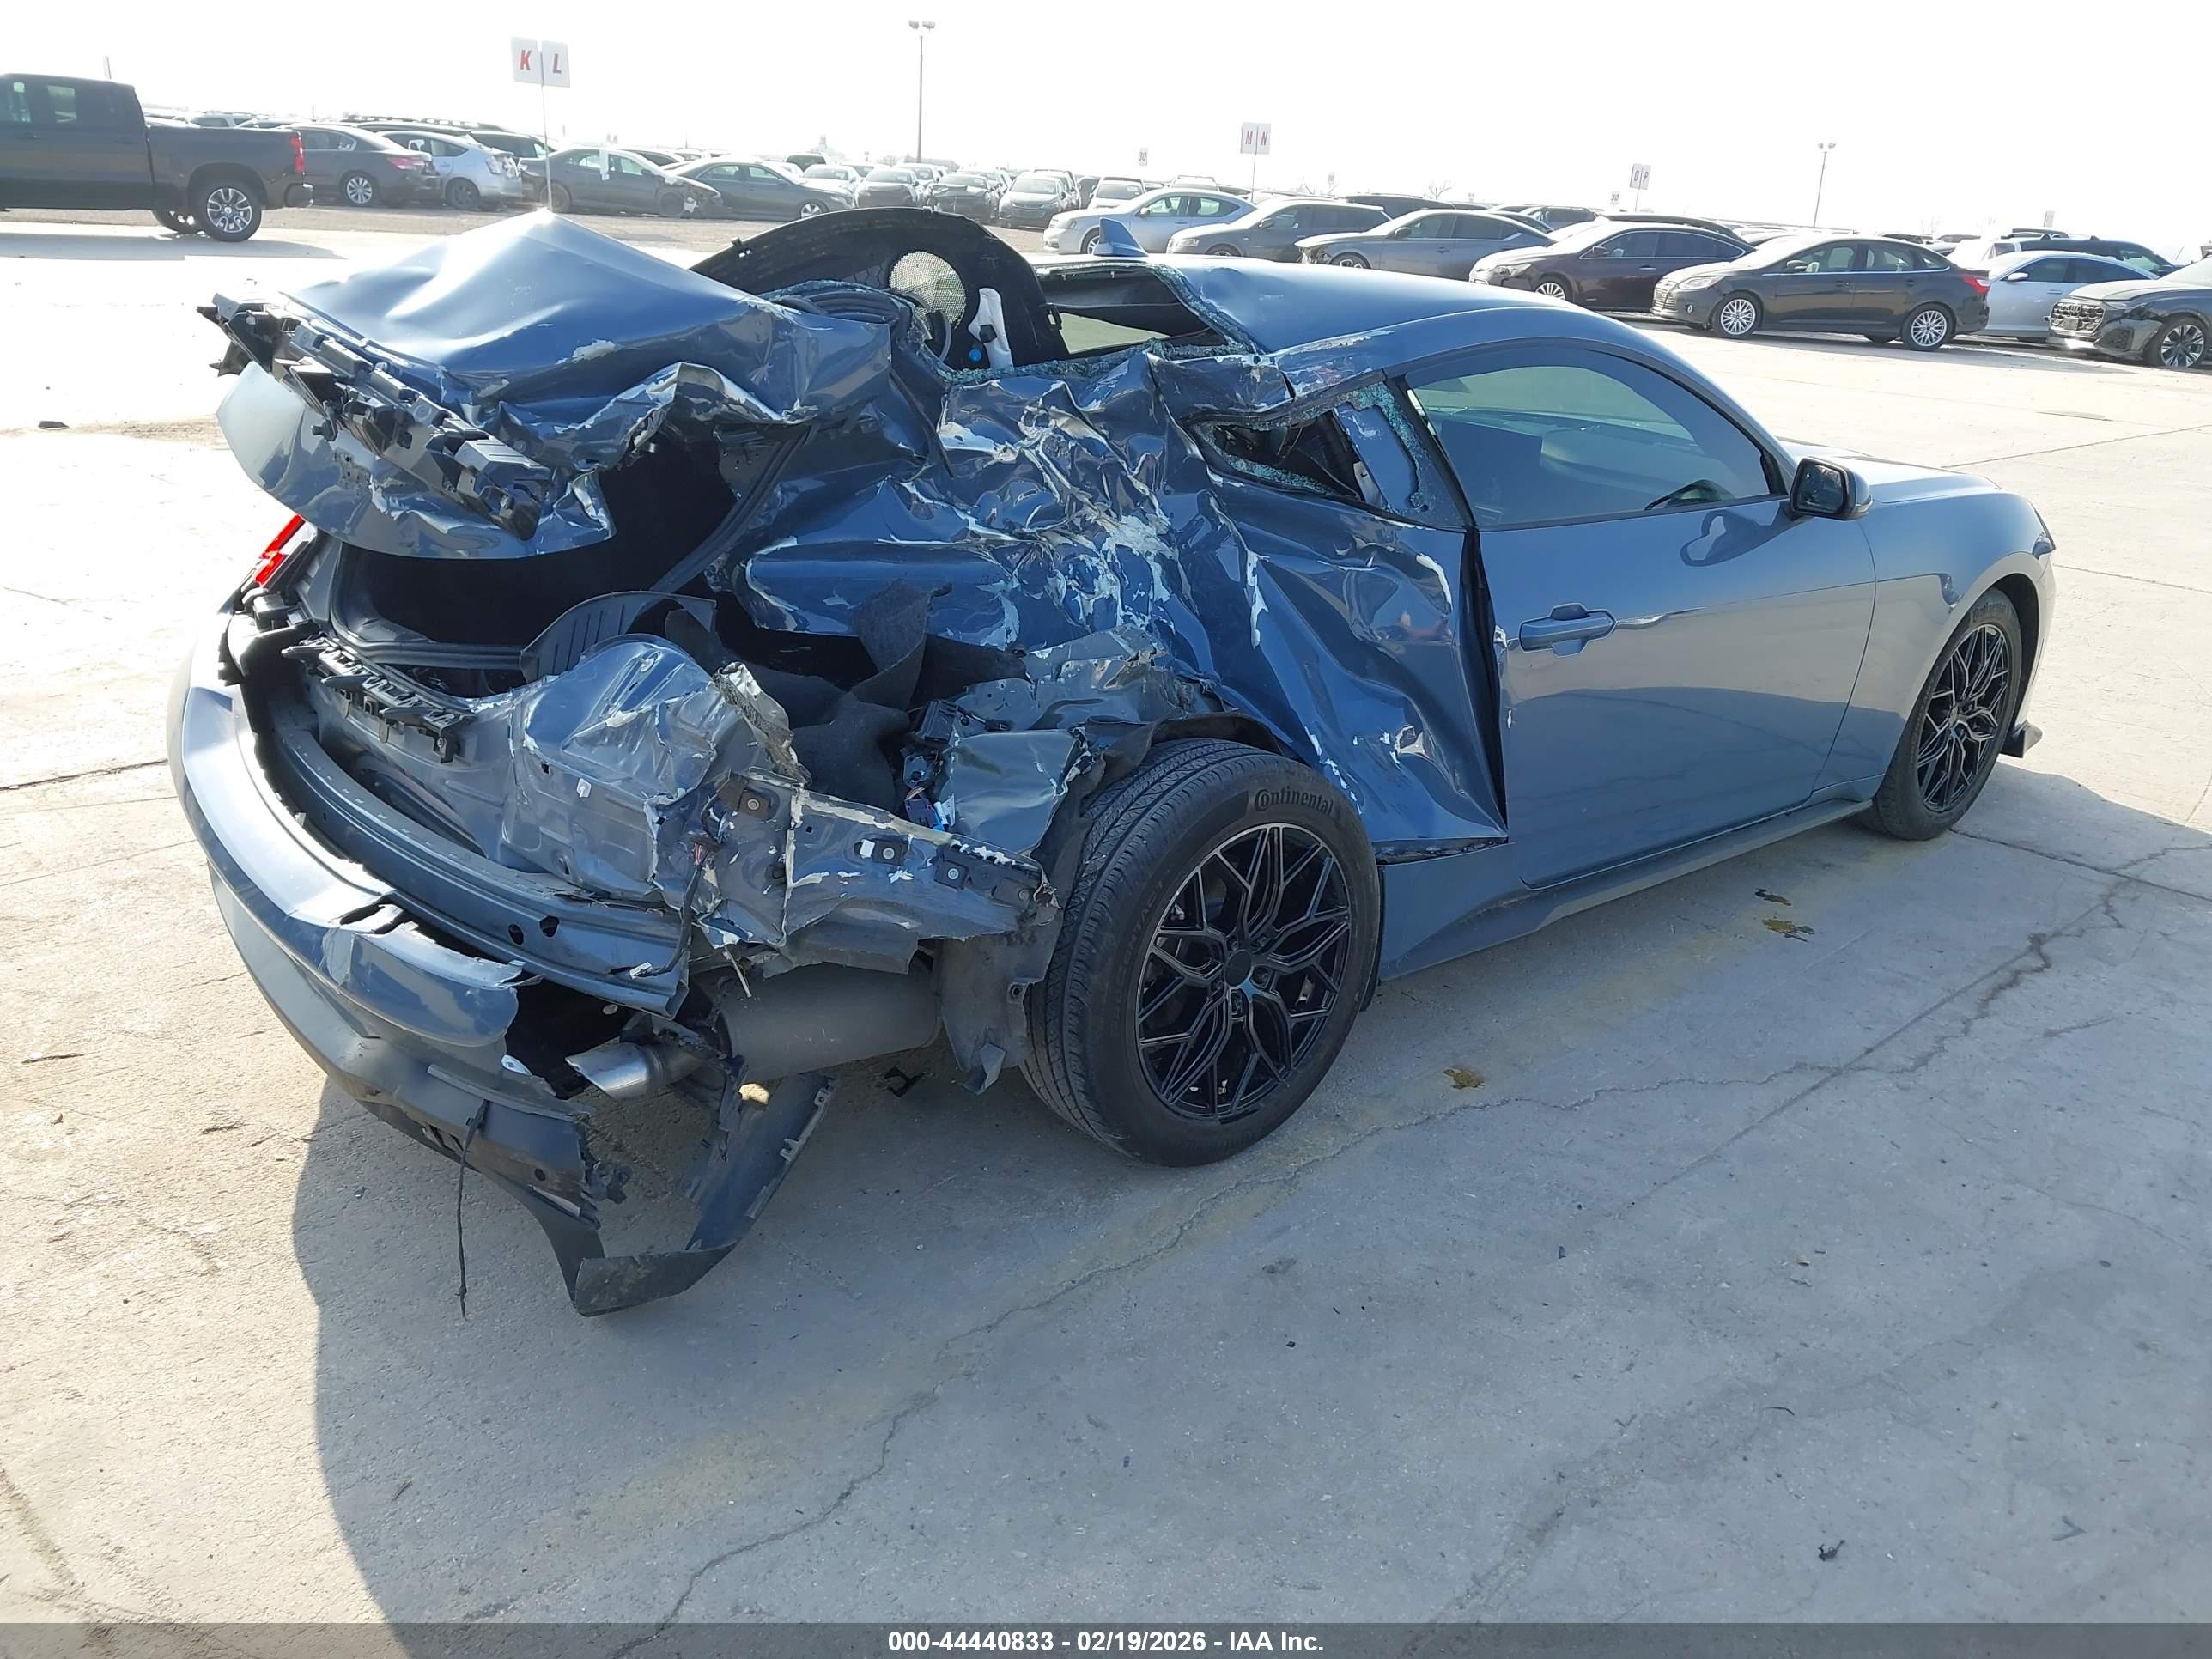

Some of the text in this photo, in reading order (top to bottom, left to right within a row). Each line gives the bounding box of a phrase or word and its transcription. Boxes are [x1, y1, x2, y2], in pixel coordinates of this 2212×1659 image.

[520, 49, 532, 70] K
[552, 52, 562, 74] L
[1245, 130, 1253, 145] M
[1261, 131, 1268, 146] N
[1643, 171, 1649, 183] P
[1255, 786, 1334, 817] Continental
